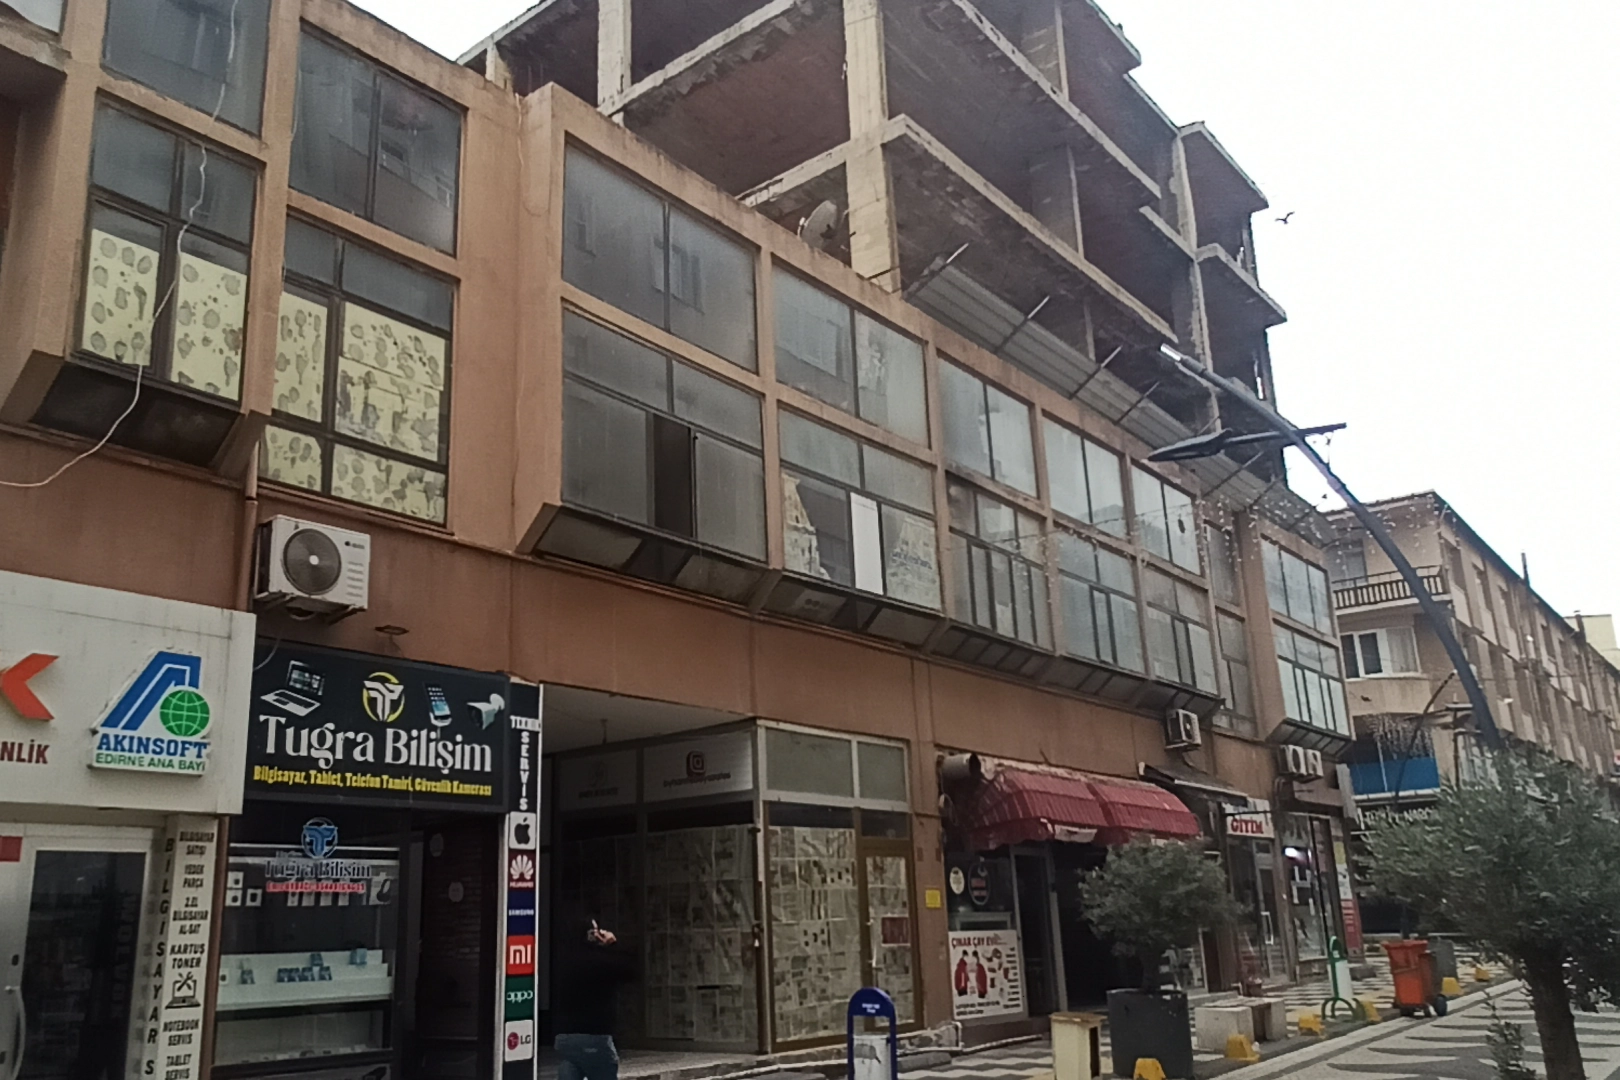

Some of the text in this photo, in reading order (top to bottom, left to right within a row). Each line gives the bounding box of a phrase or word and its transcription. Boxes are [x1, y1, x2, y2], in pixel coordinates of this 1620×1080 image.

[97, 733, 210, 759] AKINSOFT
[385, 727, 492, 775] Bilişim
[148, 758, 175, 769] ANA
[172, 957, 201, 969] TONER
[162, 1019, 200, 1032] NOTEBOOK
[520, 1034, 531, 1044] LG
[166, 1054, 192, 1067] TABLET
